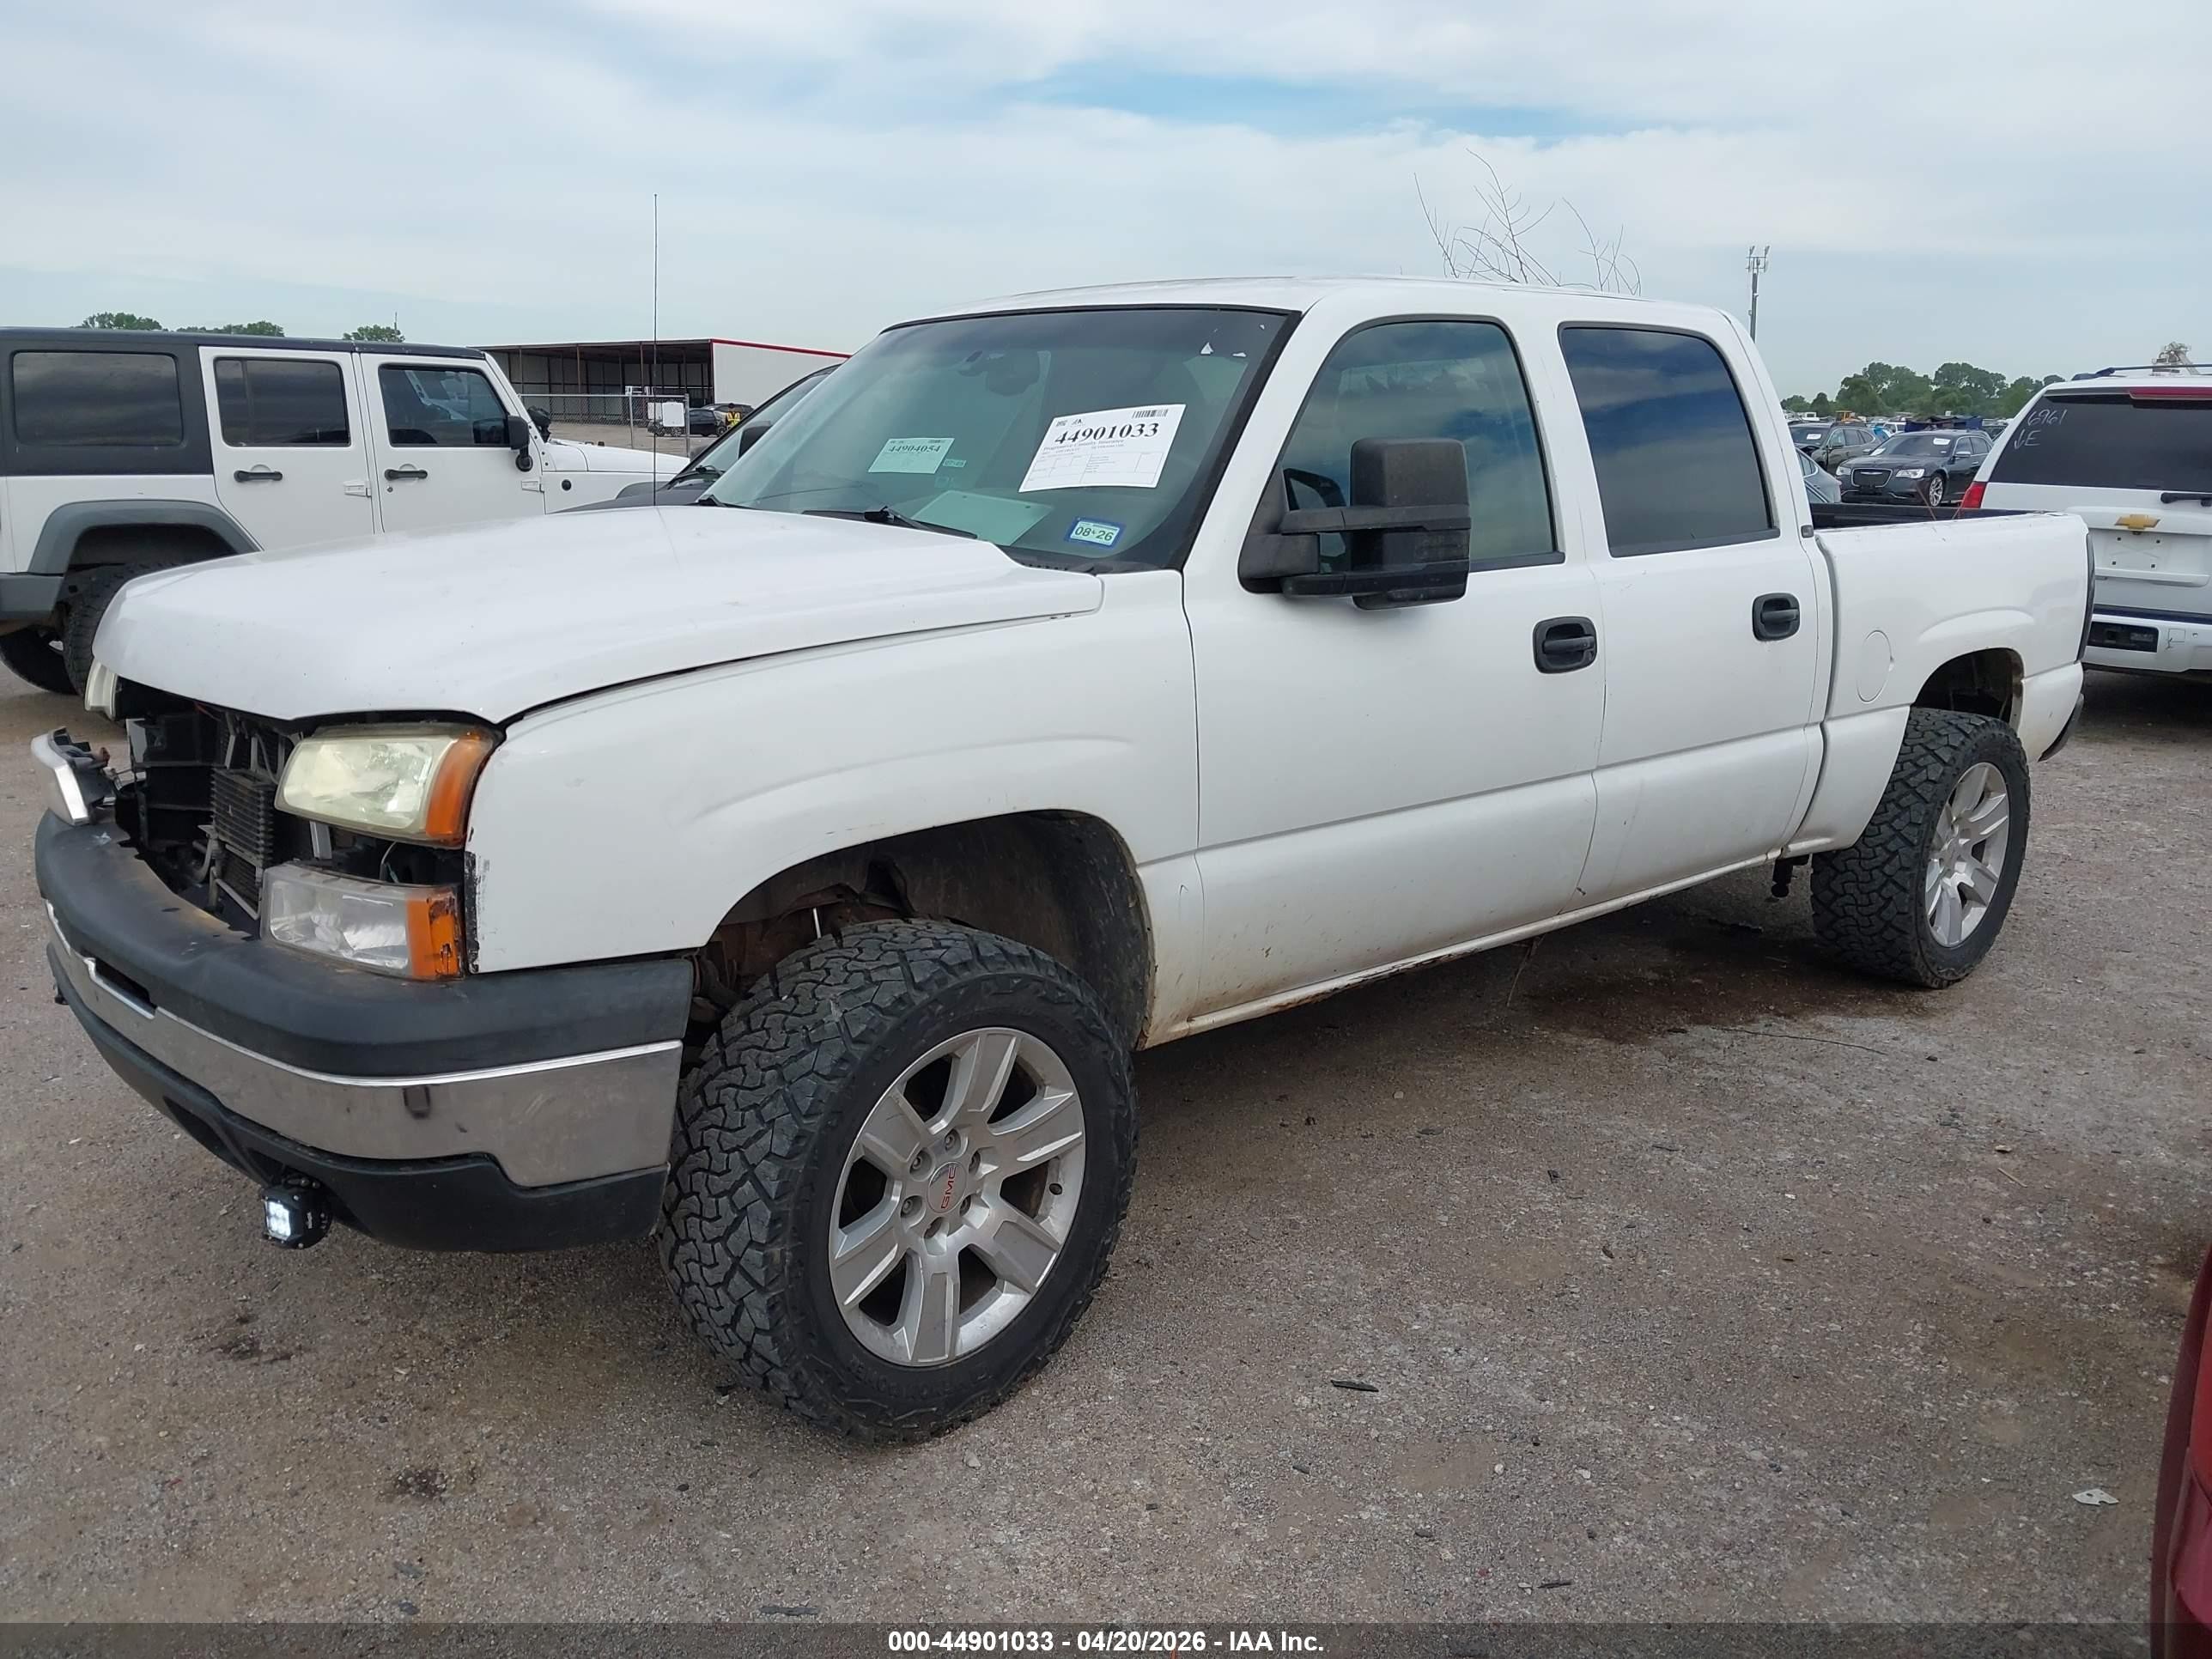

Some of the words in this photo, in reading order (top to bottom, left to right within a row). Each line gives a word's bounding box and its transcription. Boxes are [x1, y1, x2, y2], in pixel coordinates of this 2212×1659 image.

[2027, 409, 2068, 426] 6961
[1054, 422, 1159, 445] 44901033
[941, 1164, 957, 1209] GMC
